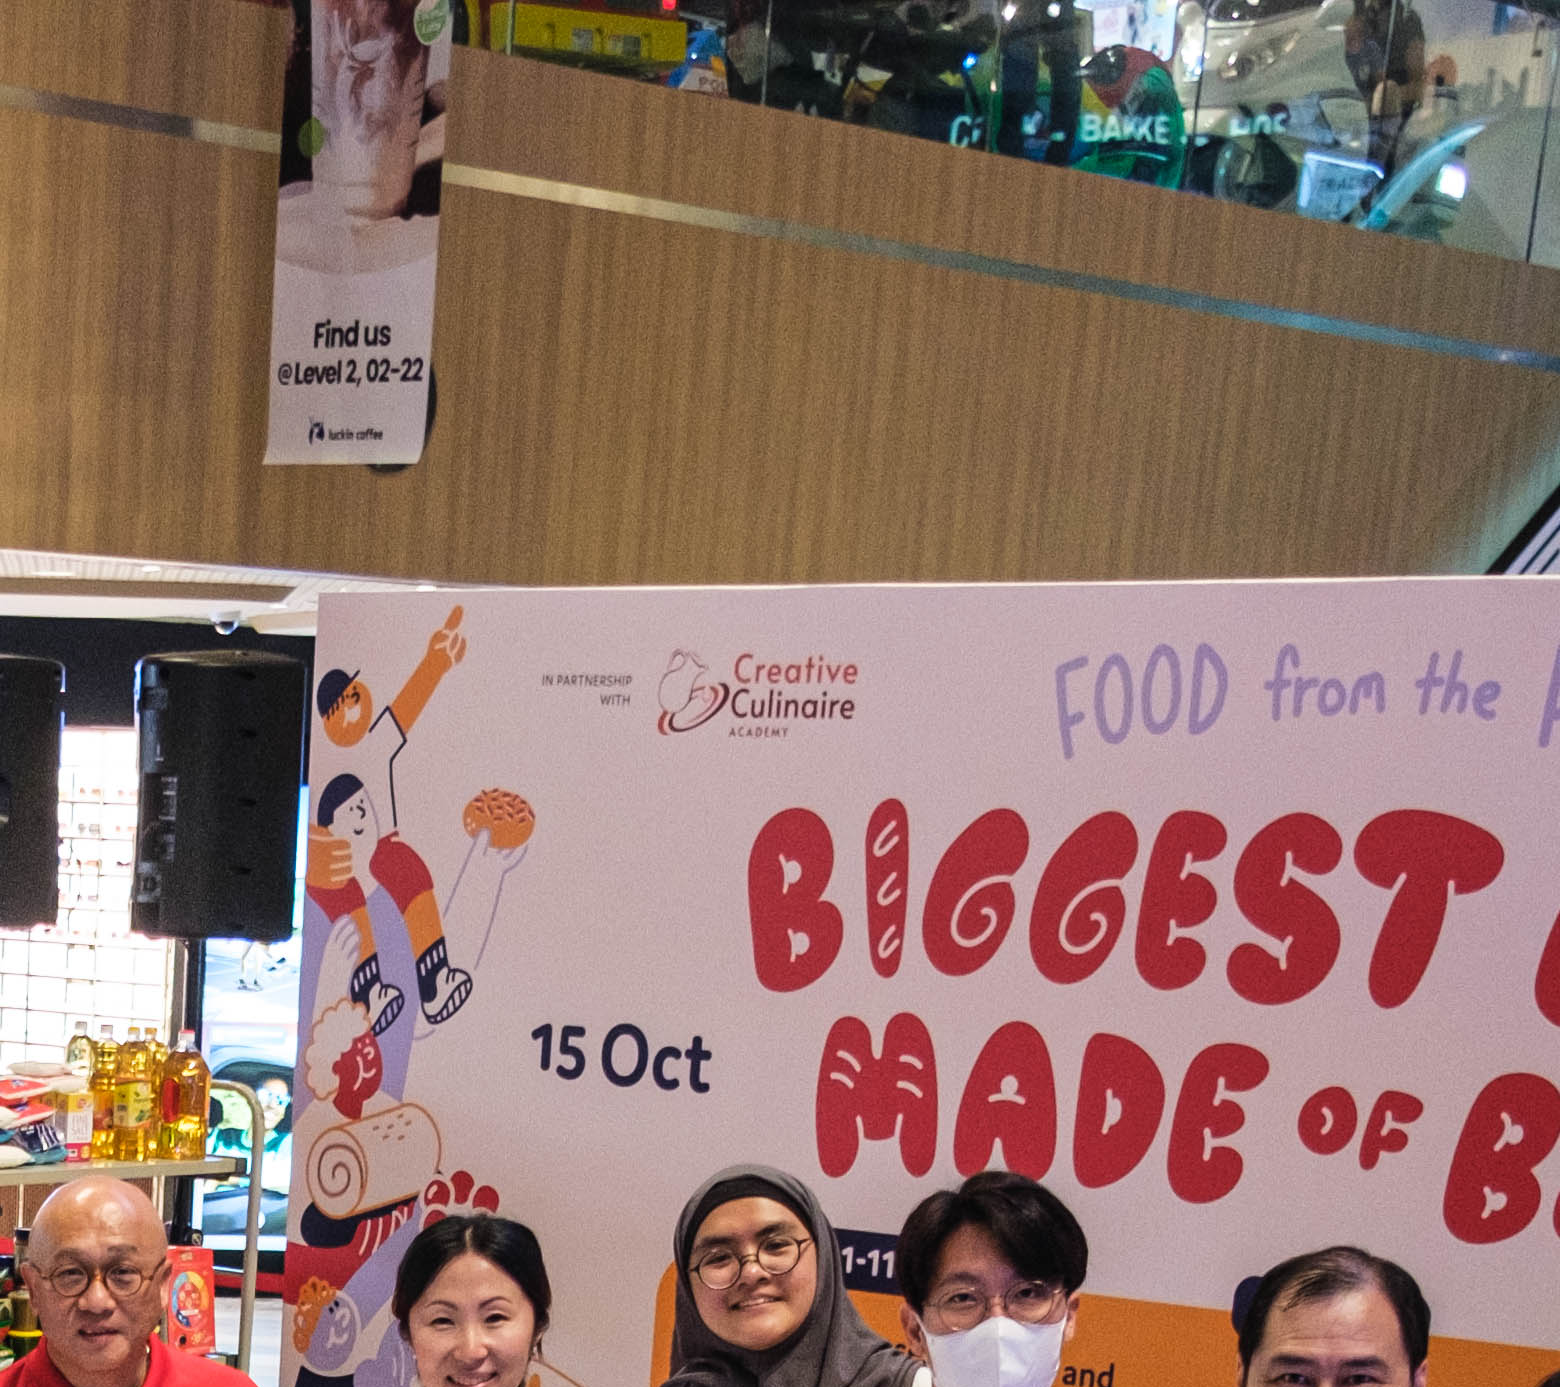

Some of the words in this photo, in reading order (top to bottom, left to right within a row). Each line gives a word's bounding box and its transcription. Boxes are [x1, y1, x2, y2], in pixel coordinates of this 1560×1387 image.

[314, 319, 359, 348] Find
[365, 325, 391, 346] us
[366, 358, 423, 384] 02-22
[356, 429, 383, 440] coffee
[541, 674, 553, 687] IN
[557, 673, 633, 689] PARTNERSHIP
[733, 653, 859, 687] Creative
[600, 693, 631, 707] WITH
[730, 688, 856, 722] Culinaire
[1055, 643, 1228, 760] FOOD
[1264, 643, 1387, 722] from
[1416, 651, 1501, 720] the
[728, 726, 789, 739] ACADEMY
[747, 797, 1504, 1009] BIGGEST
[531, 1022, 586, 1081] 15
[602, 1023, 712, 1094] Oct
[815, 1012, 1270, 1203] MADE
[1297, 1086, 1424, 1170] OF
